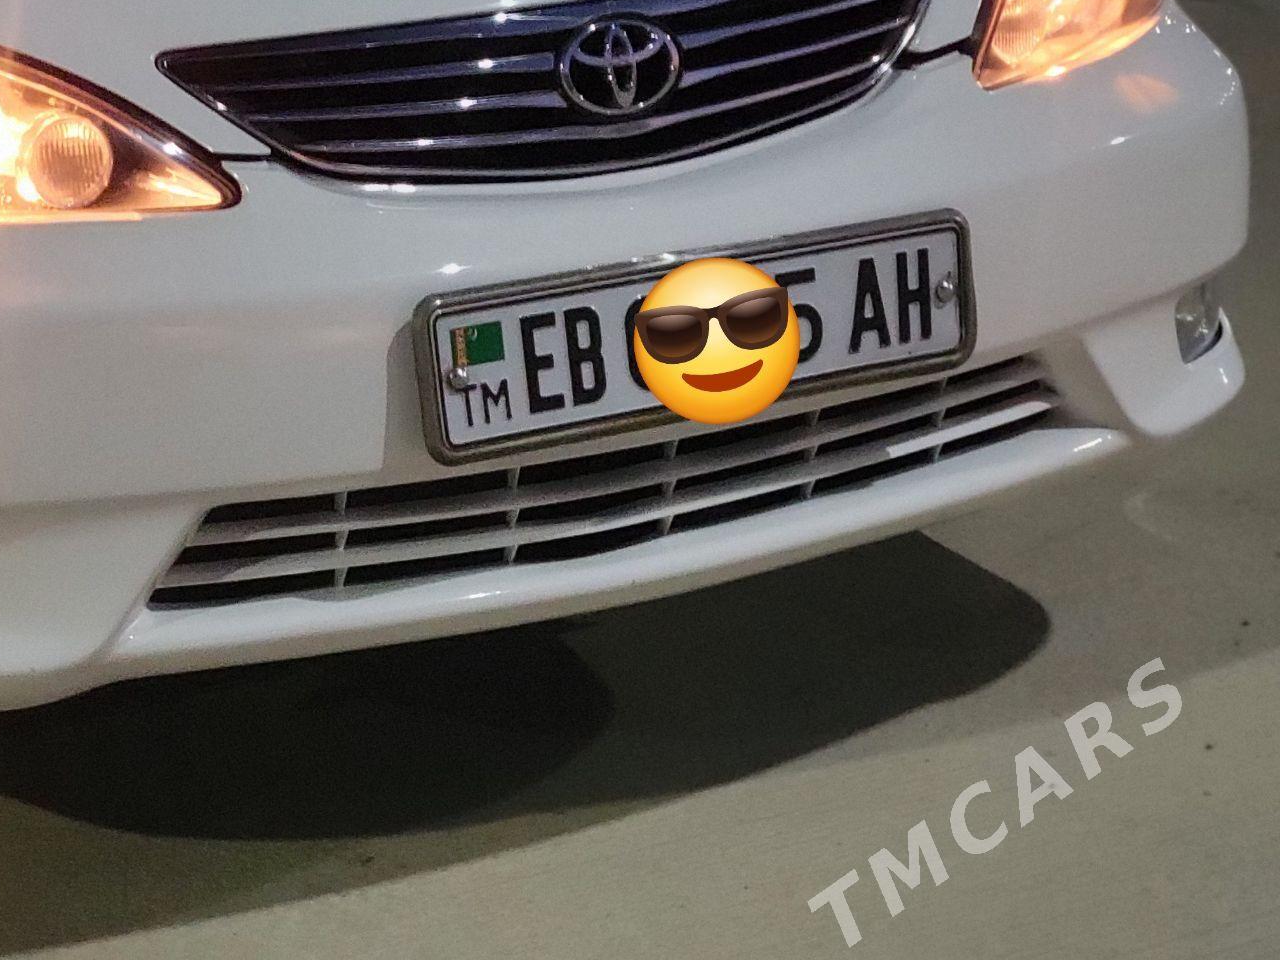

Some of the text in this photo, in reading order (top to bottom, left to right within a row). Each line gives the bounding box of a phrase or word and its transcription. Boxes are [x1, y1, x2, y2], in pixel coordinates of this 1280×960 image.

[519, 306, 607, 415] EB
[848, 248, 933, 354] AH
[460, 378, 513, 427] TM
